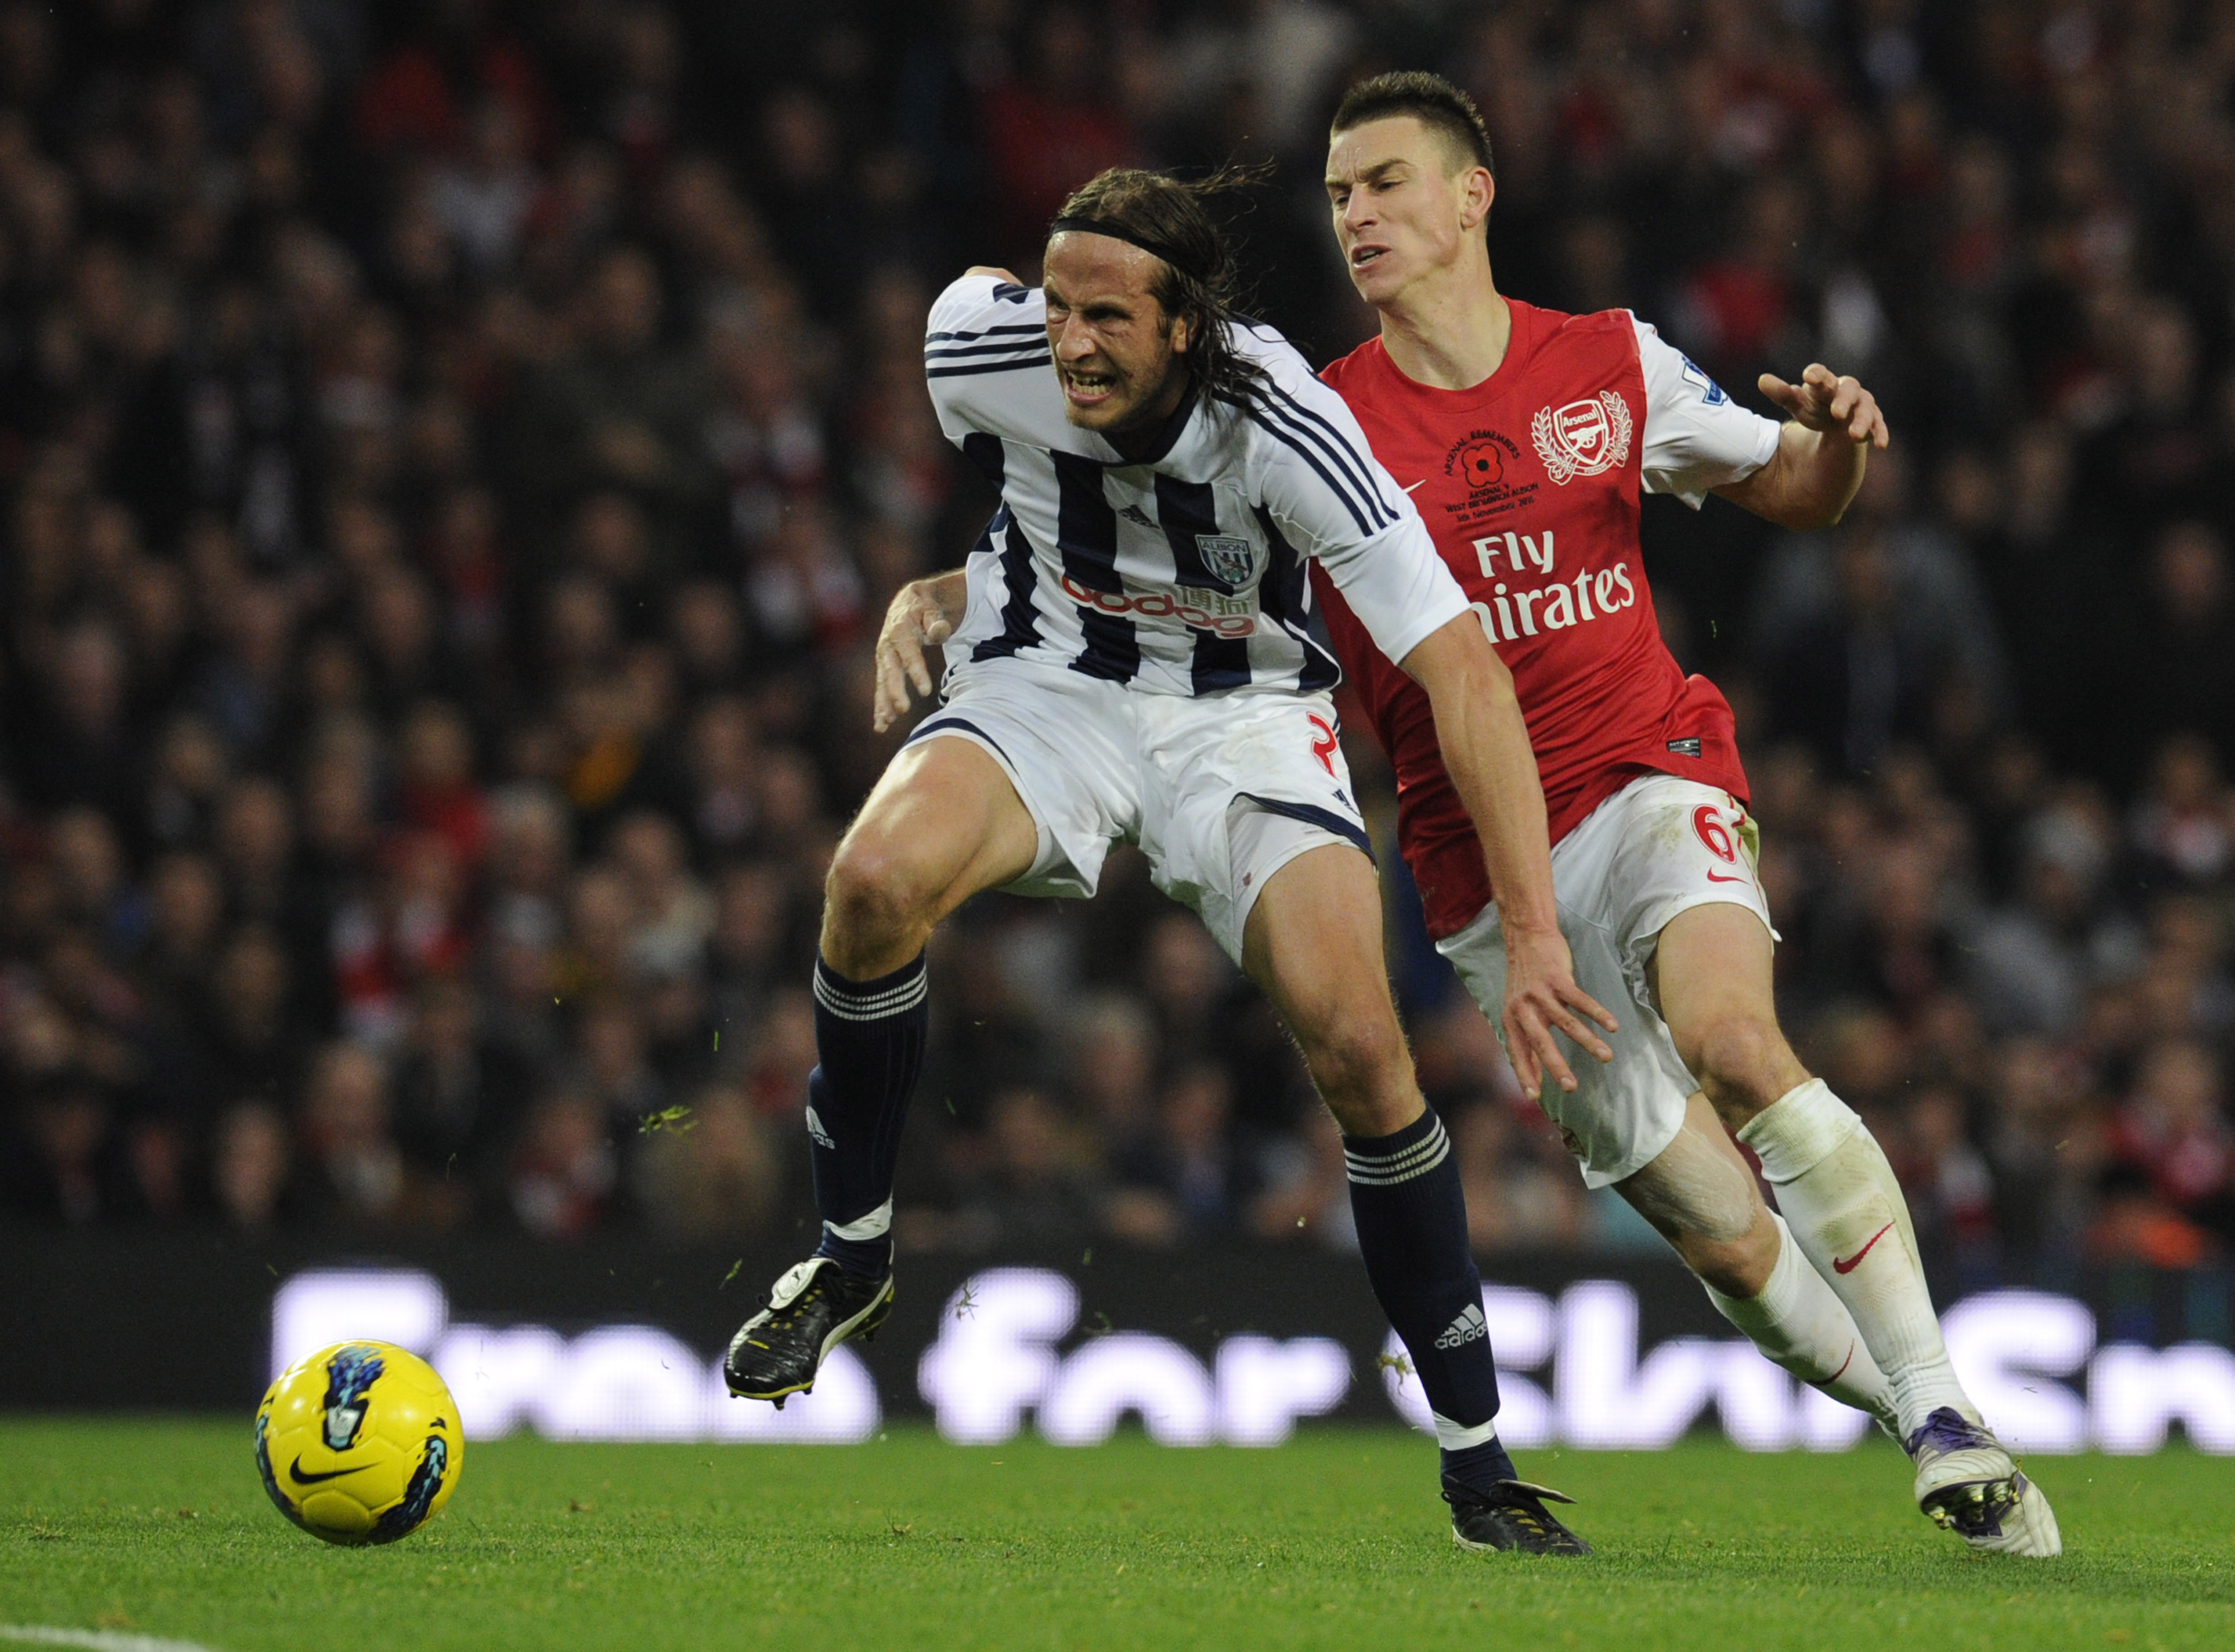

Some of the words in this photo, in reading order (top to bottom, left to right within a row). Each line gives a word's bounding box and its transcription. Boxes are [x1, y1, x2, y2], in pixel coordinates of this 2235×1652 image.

[1563, 408, 1598, 427] Arsenal
[1203, 541, 1246, 552] ALBION
[1472, 530, 1554, 579] Fly
[1470, 562, 1635, 644] irates
[1690, 803, 1737, 865] 6
